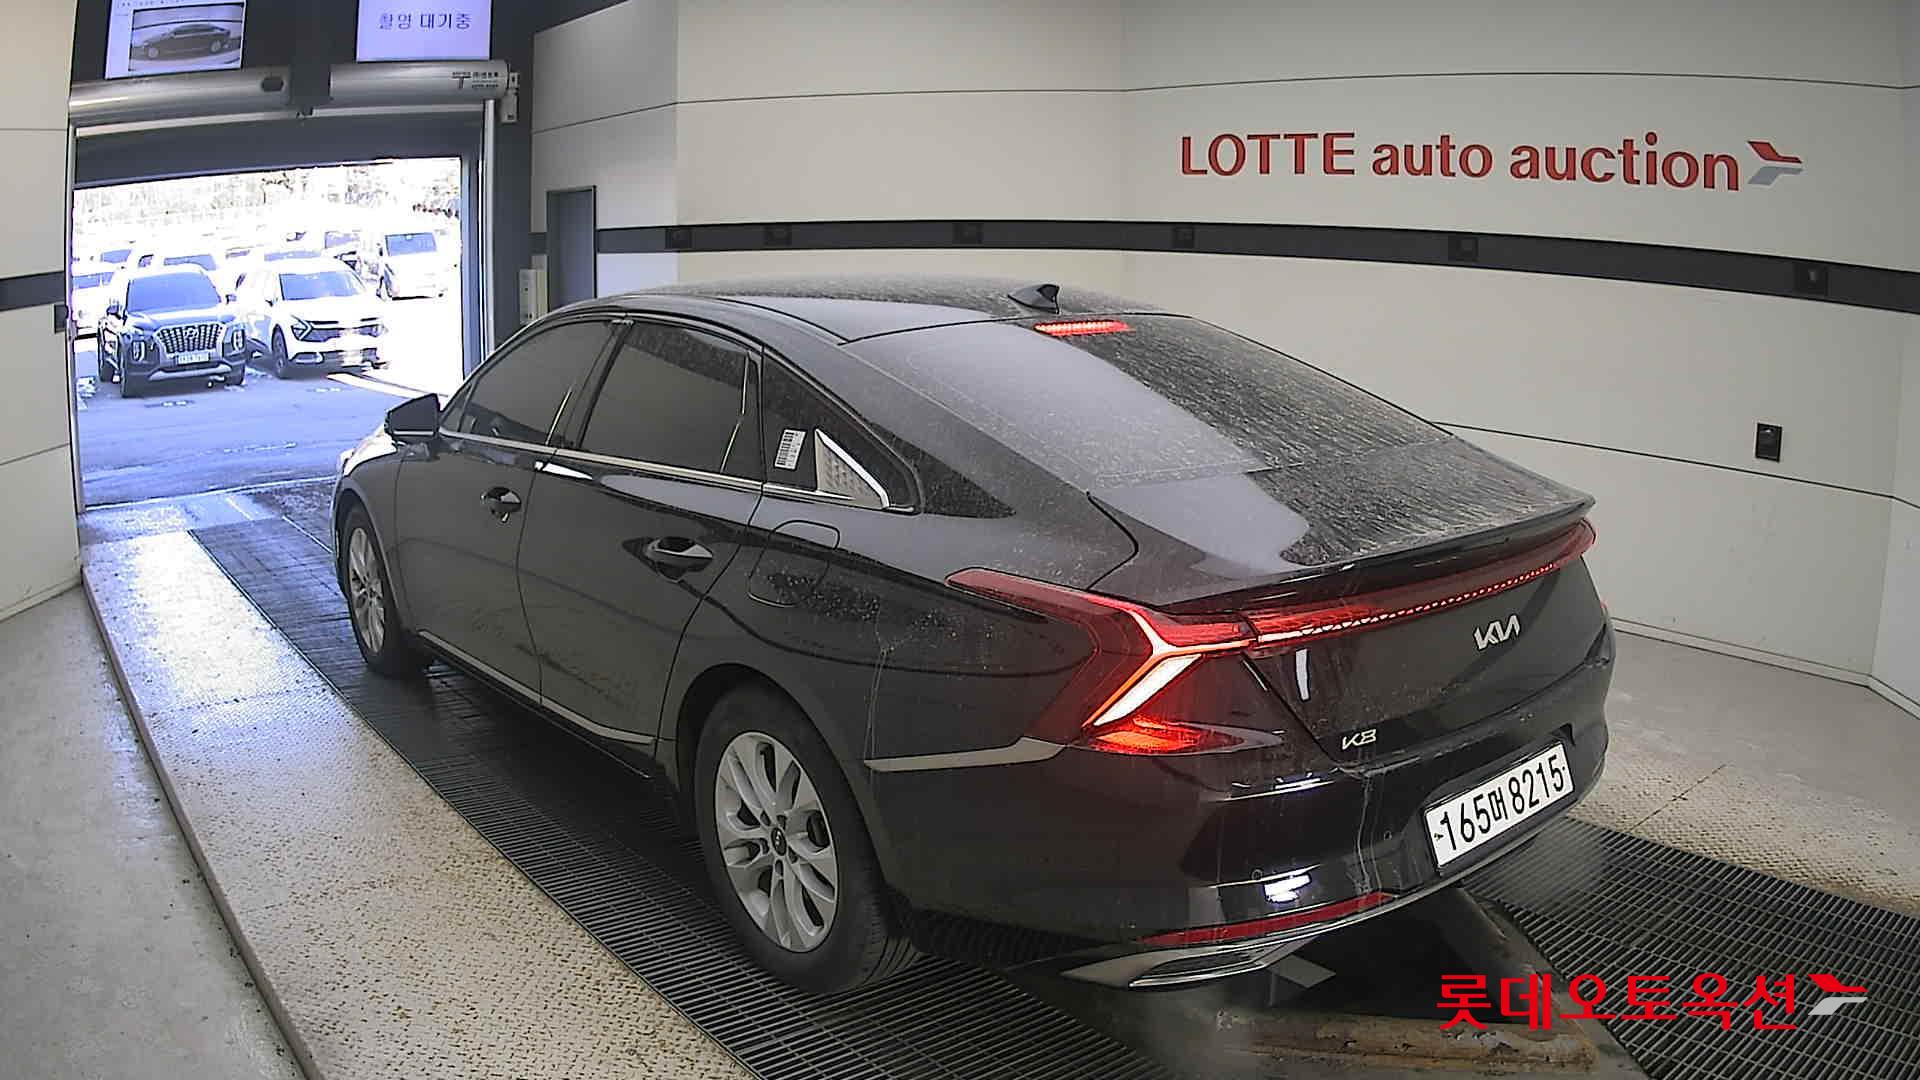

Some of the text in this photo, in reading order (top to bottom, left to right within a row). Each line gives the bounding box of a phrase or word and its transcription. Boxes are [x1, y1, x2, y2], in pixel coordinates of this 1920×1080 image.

[420, 13, 472, 30] 대기중
[1182, 131, 1740, 191] LOTTE auto auction
[1341, 728, 1377, 750] K8
